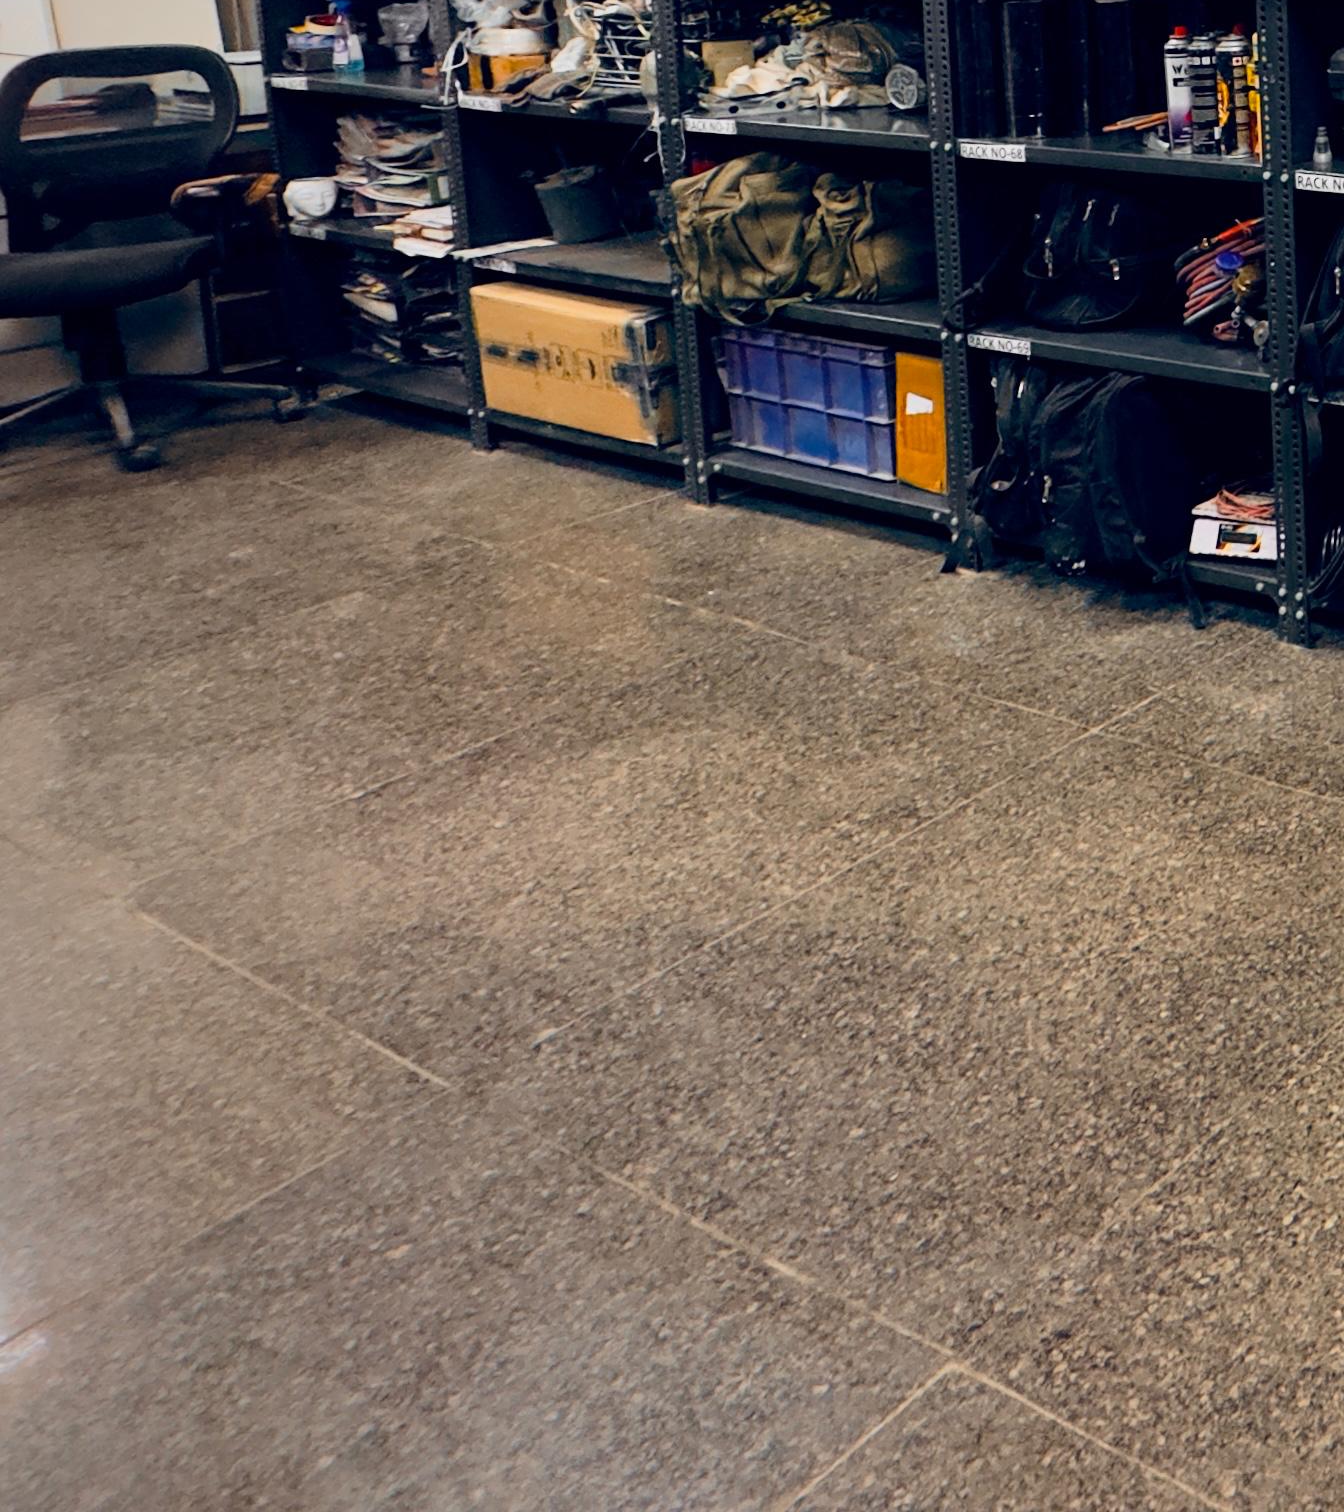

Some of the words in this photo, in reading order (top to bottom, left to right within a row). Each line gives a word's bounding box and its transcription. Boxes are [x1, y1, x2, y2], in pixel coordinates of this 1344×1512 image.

[961, 145, 988, 158] RACK
[991, 147, 1023, 160] NO-68
[1297, 175, 1329, 191] RACK
[968, 335, 994, 349] RACK
